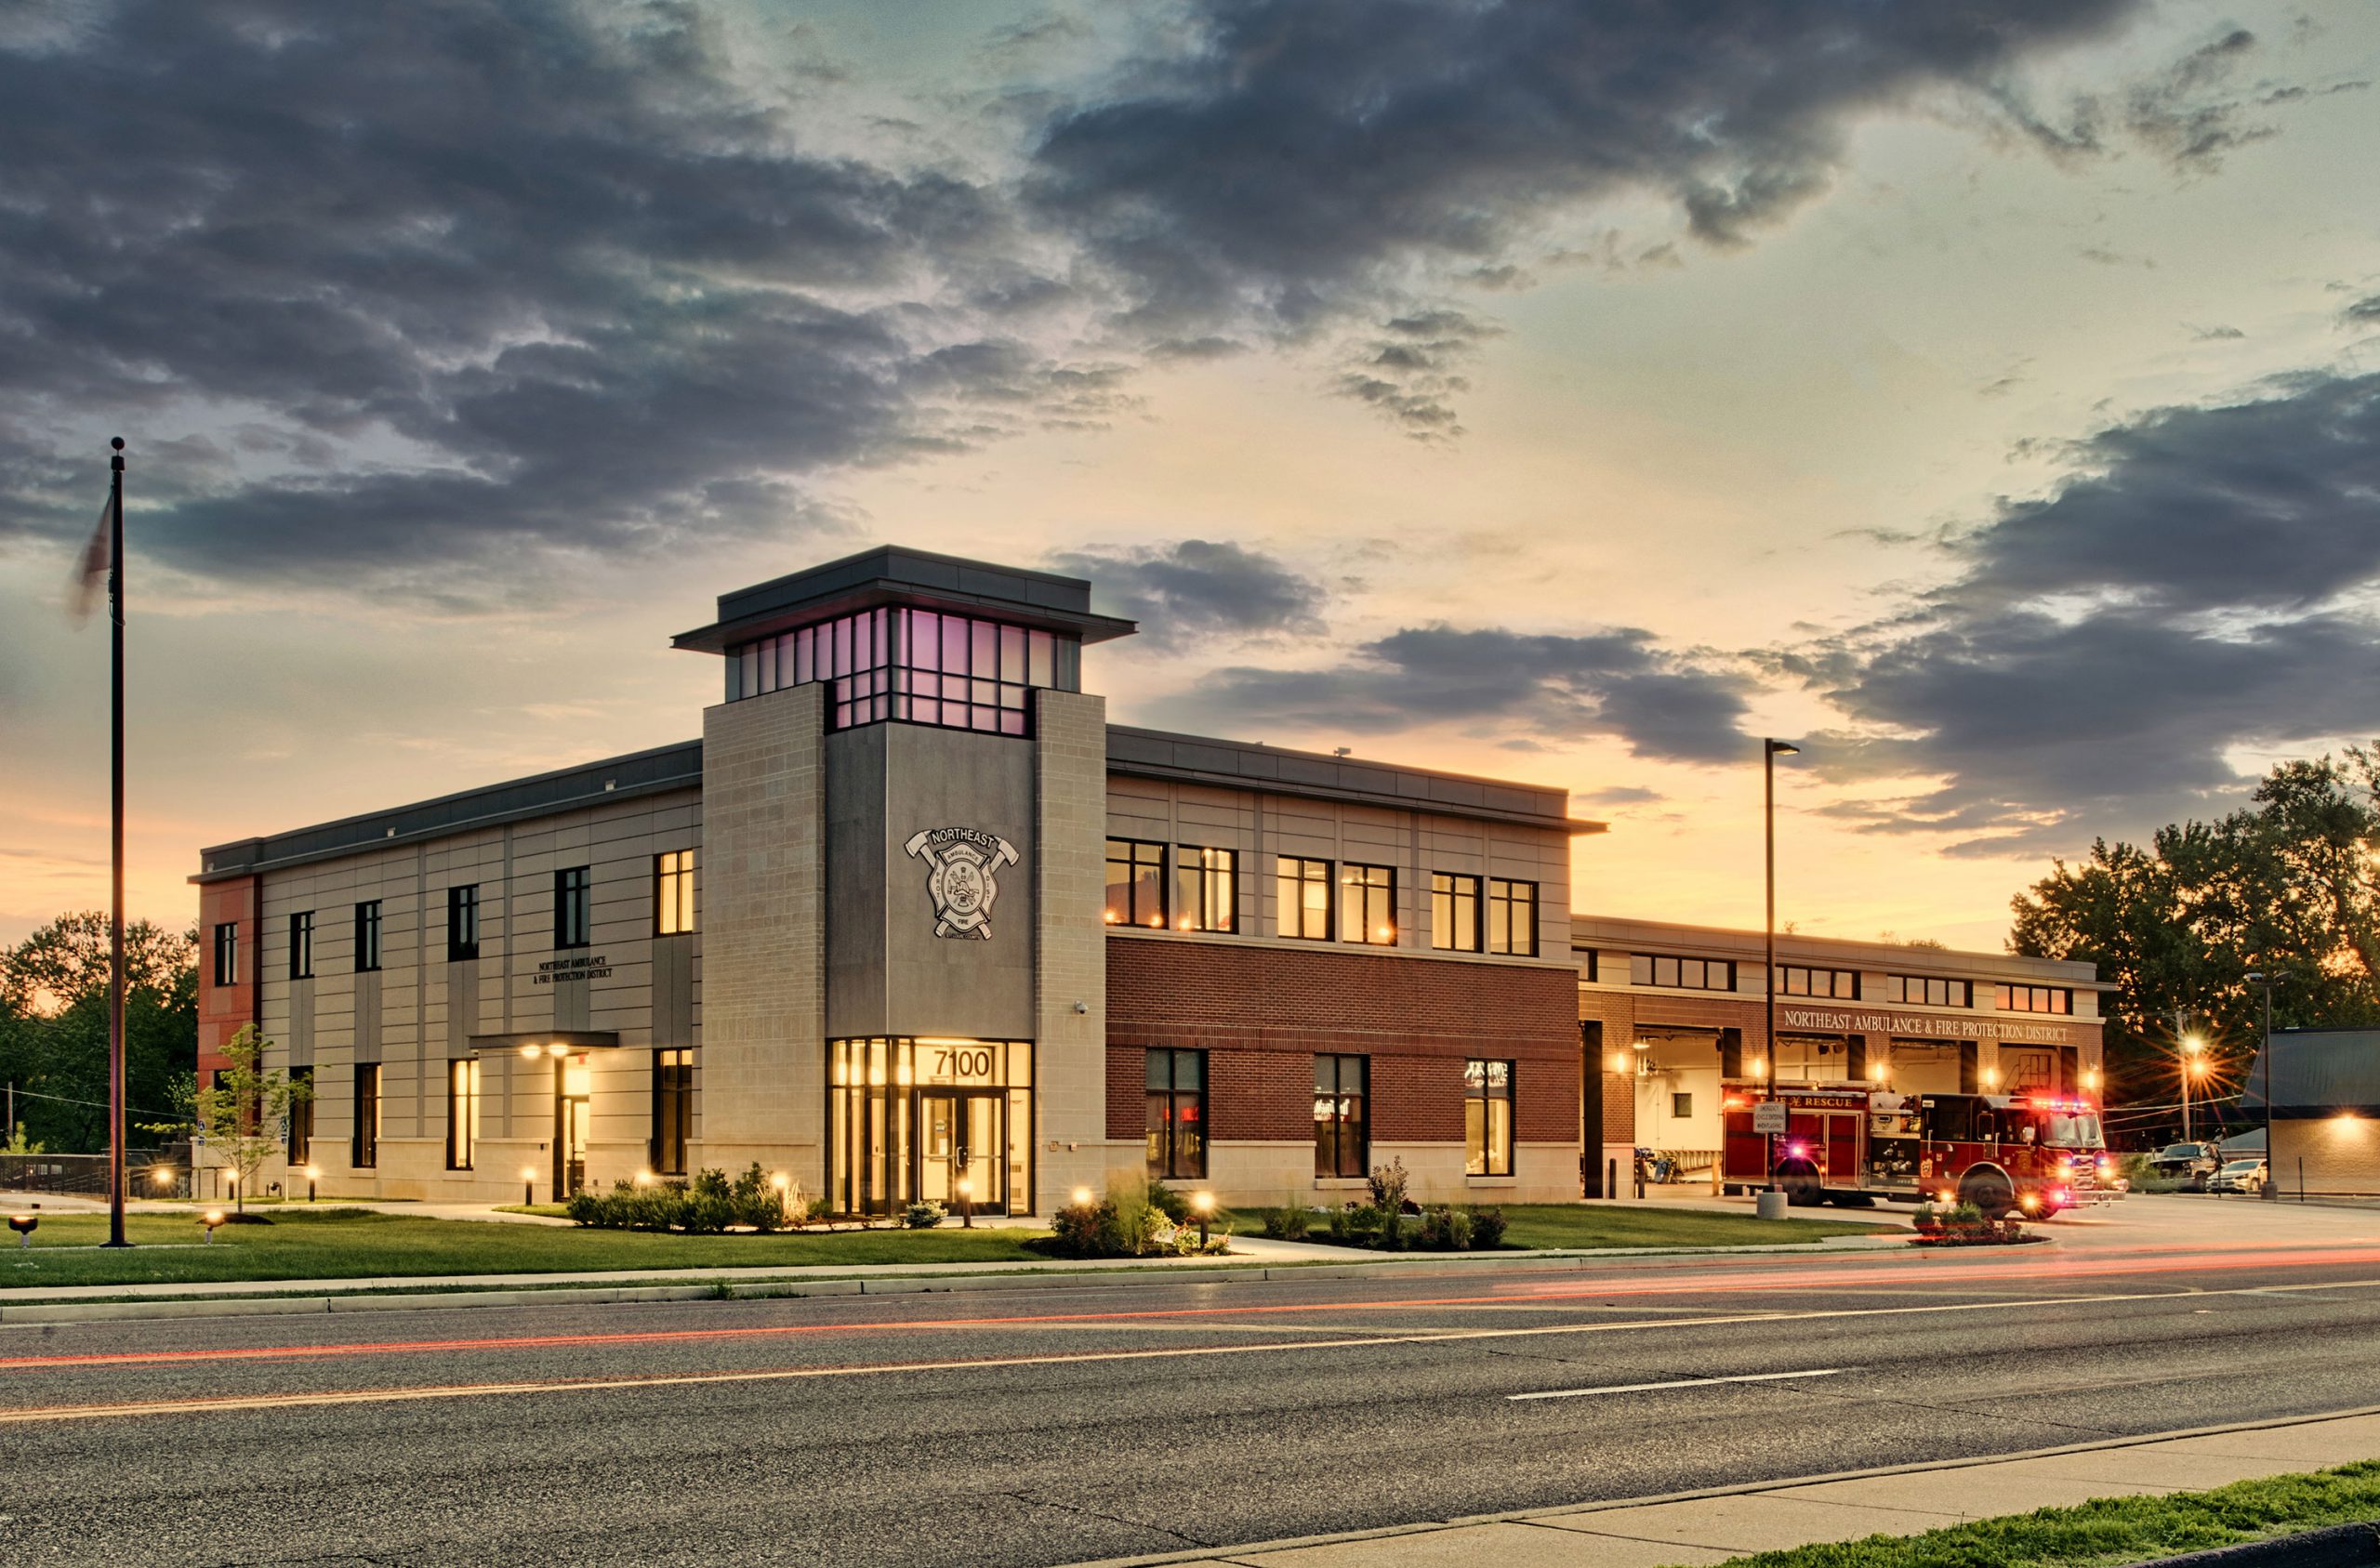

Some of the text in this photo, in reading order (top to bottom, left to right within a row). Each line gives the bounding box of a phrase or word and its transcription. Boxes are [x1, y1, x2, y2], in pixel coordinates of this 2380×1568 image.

[932, 827, 995, 848] NORTHEAST
[947, 849, 979, 861] AMBULANCE
[539, 955, 606, 971] NORTHEAST AMBULANCE
[539, 973, 550, 983] FIRE
[552, 970, 586, 982] PROTECTION
[587, 968, 613, 980] DISTRICT
[1784, 1010, 2068, 1042] NORTHEAST AMBULANCE & FIRE PROTECTION DISTRICT
[934, 1050, 989, 1076] 7100
[1805, 1097, 1853, 1107] RESCUE
